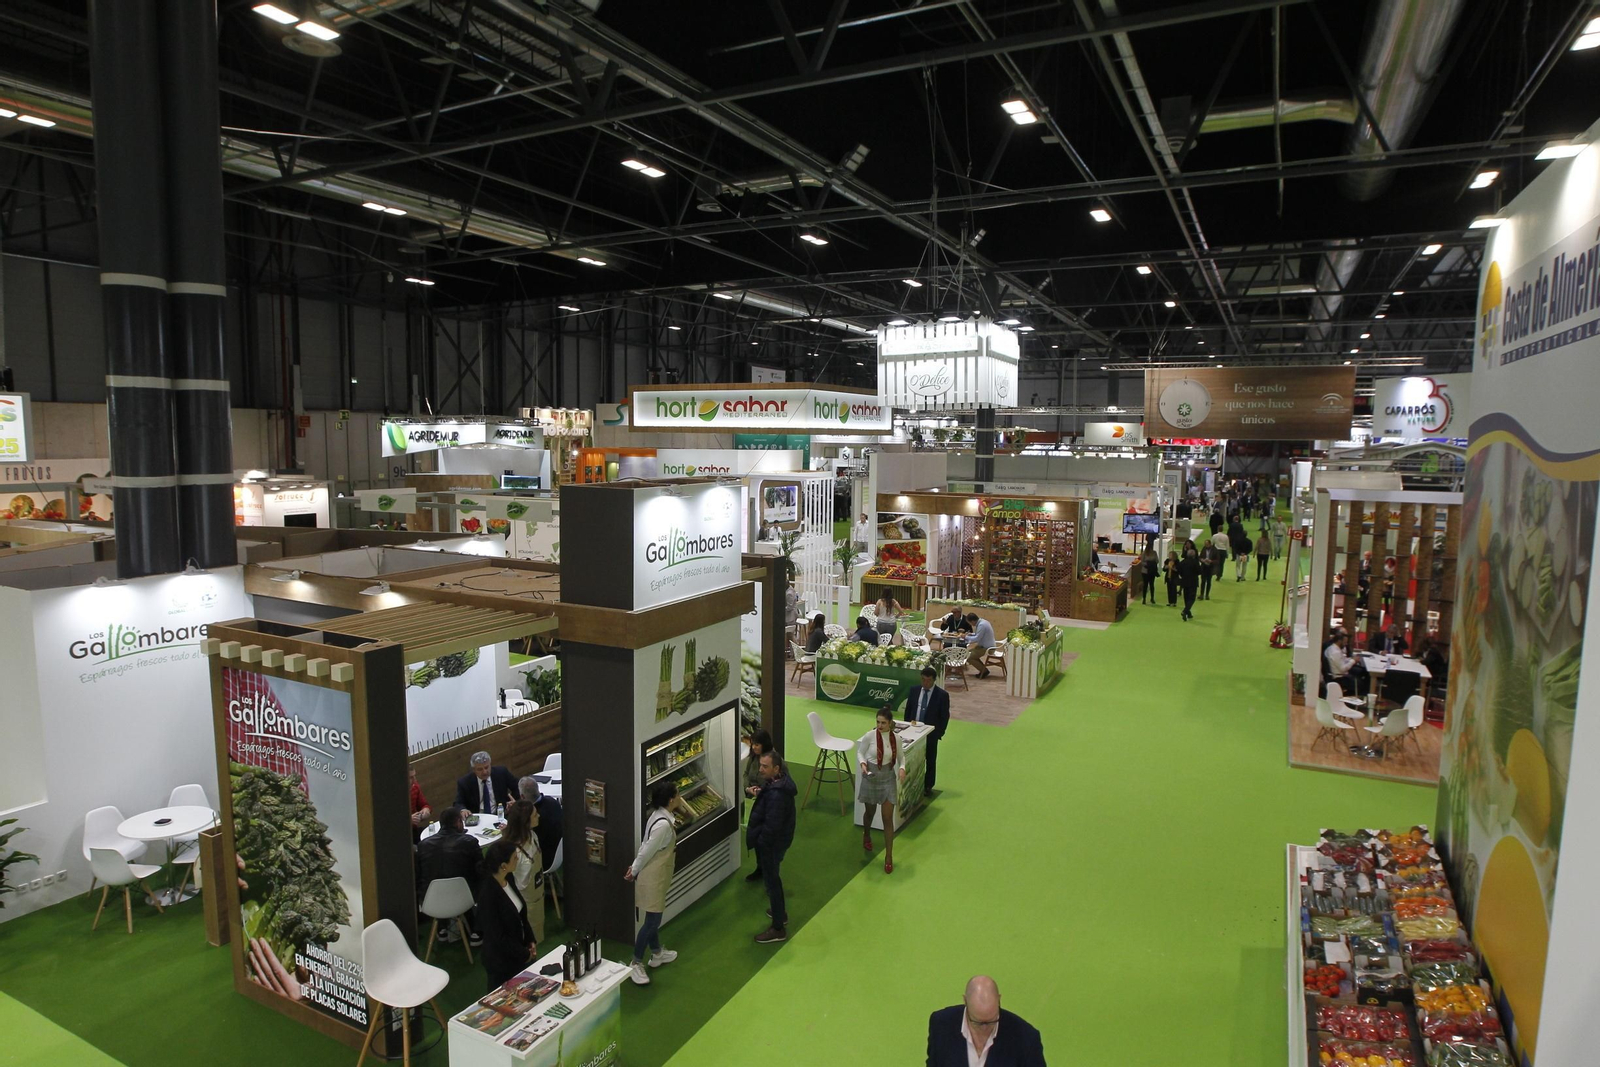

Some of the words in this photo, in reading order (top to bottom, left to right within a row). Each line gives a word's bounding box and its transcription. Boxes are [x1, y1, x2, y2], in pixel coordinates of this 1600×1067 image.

[1503, 281, 1532, 346] Costa
[1532, 266, 1548, 335] de
[1234, 383, 1253, 392] Ese
[1256, 385, 1286, 395] gusto
[723, 396, 787, 412] sabor
[852, 401, 881, 415] sabor
[1225, 401, 1245, 410] que
[1268, 400, 1294, 408] hace
[1385, 403, 1436, 416] CAPARRÓS
[1241, 414, 1276, 424] únicos
[408, 430, 460, 443] AGRIDEMUR
[646, 527, 734, 564] Gallombares
[650, 572, 682, 592] Espárragos
[684, 567, 702, 578] frescos
[703, 565, 715, 574] todo
[69, 623, 207, 659] Gallombare
[79, 662, 133, 684] Espárragos
[136, 656, 168, 669] frescos
[171, 651, 190, 661] todo
[190, 649, 200, 659] el
[241, 696, 253, 705] LOS
[229, 690, 351, 751] Gallombares
[236, 740, 275, 759] Espárragos
[276, 745, 302, 762] frescos
[303, 755, 320, 769] todo
[323, 763, 331, 775] el
[333, 769, 347, 781] año
[306, 943, 333, 964] AHORRO
[333, 954, 347, 971] DEL
[295, 953, 304, 966] EN
[305, 958, 335, 982] ENERGÍA,
[336, 971, 366, 994] GRACIAS
[300, 984, 311, 998] DE
[310, 990, 336, 1011] PLACAS
[336, 1002, 367, 1025] SOLARES
[309, 974, 315, 986] A
[315, 976, 325, 991] LA
[325, 980, 367, 1010] UTILIZACIÓN
